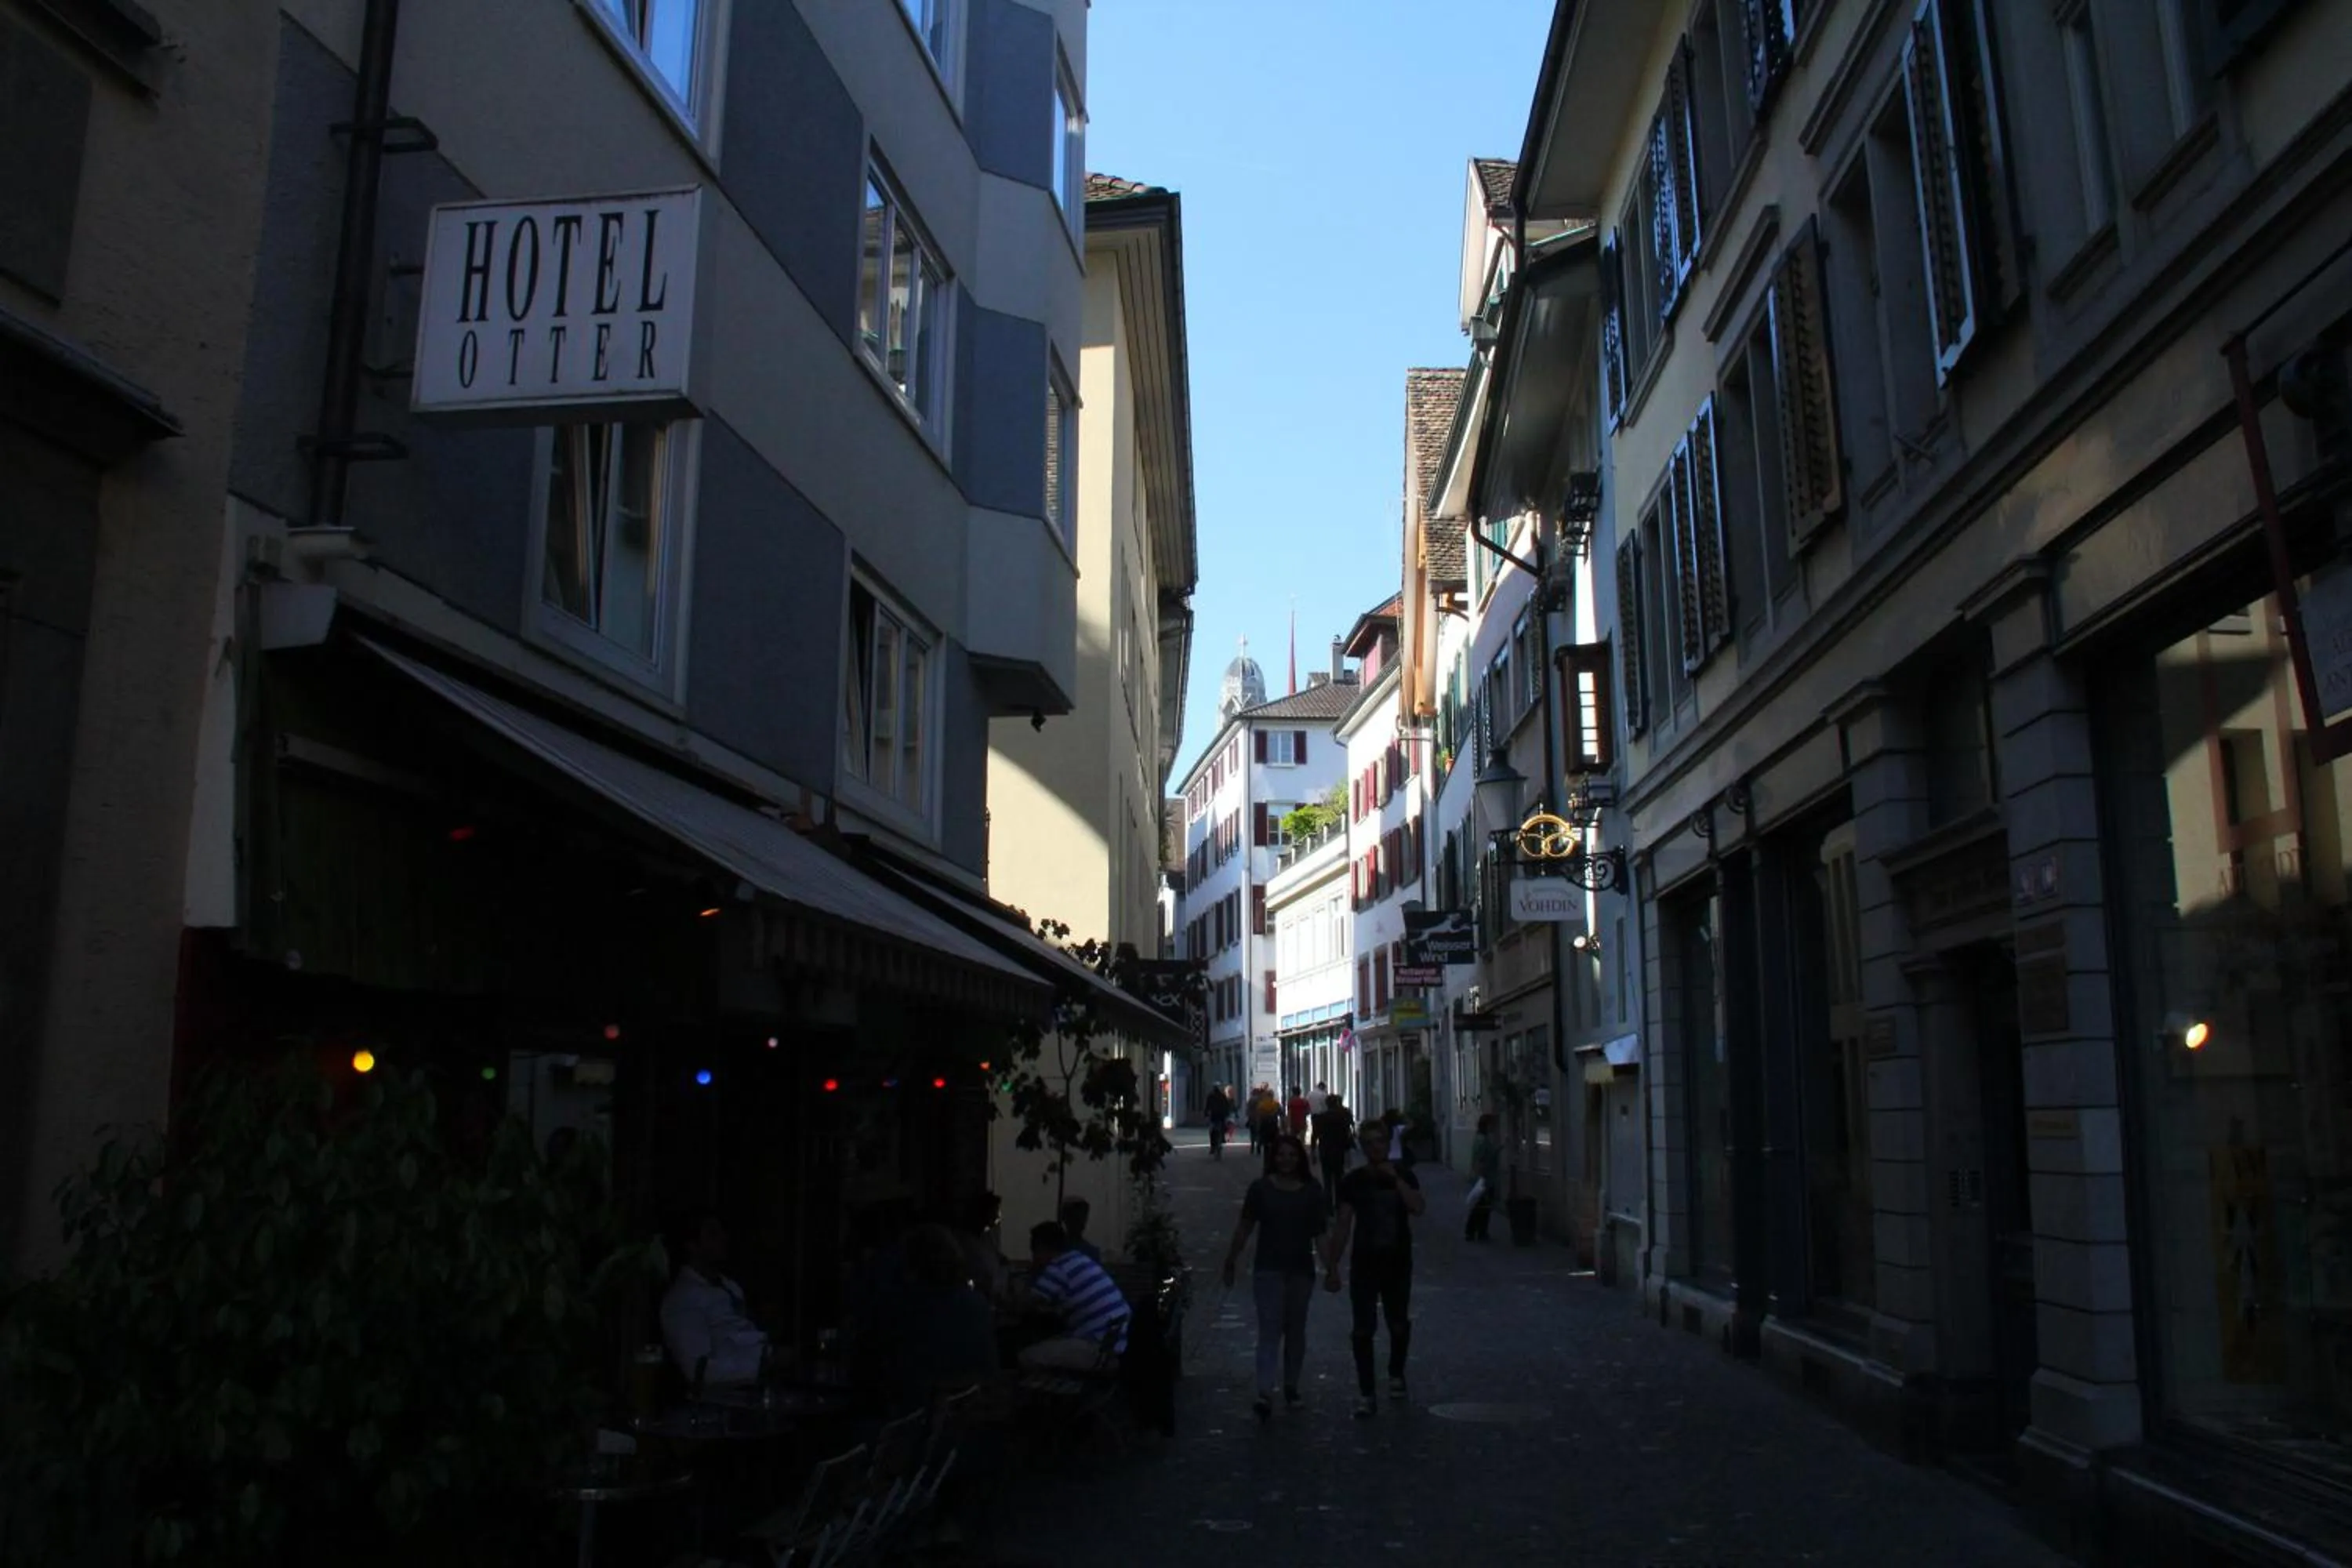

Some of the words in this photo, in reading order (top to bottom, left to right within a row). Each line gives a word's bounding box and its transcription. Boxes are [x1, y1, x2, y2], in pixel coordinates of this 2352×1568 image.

[456, 209, 668, 323] HOTEL
[459, 321, 657, 388] OTTER
[1519, 899, 1577, 913] VOHDIN
[1419, 951, 1449, 964] Wind
